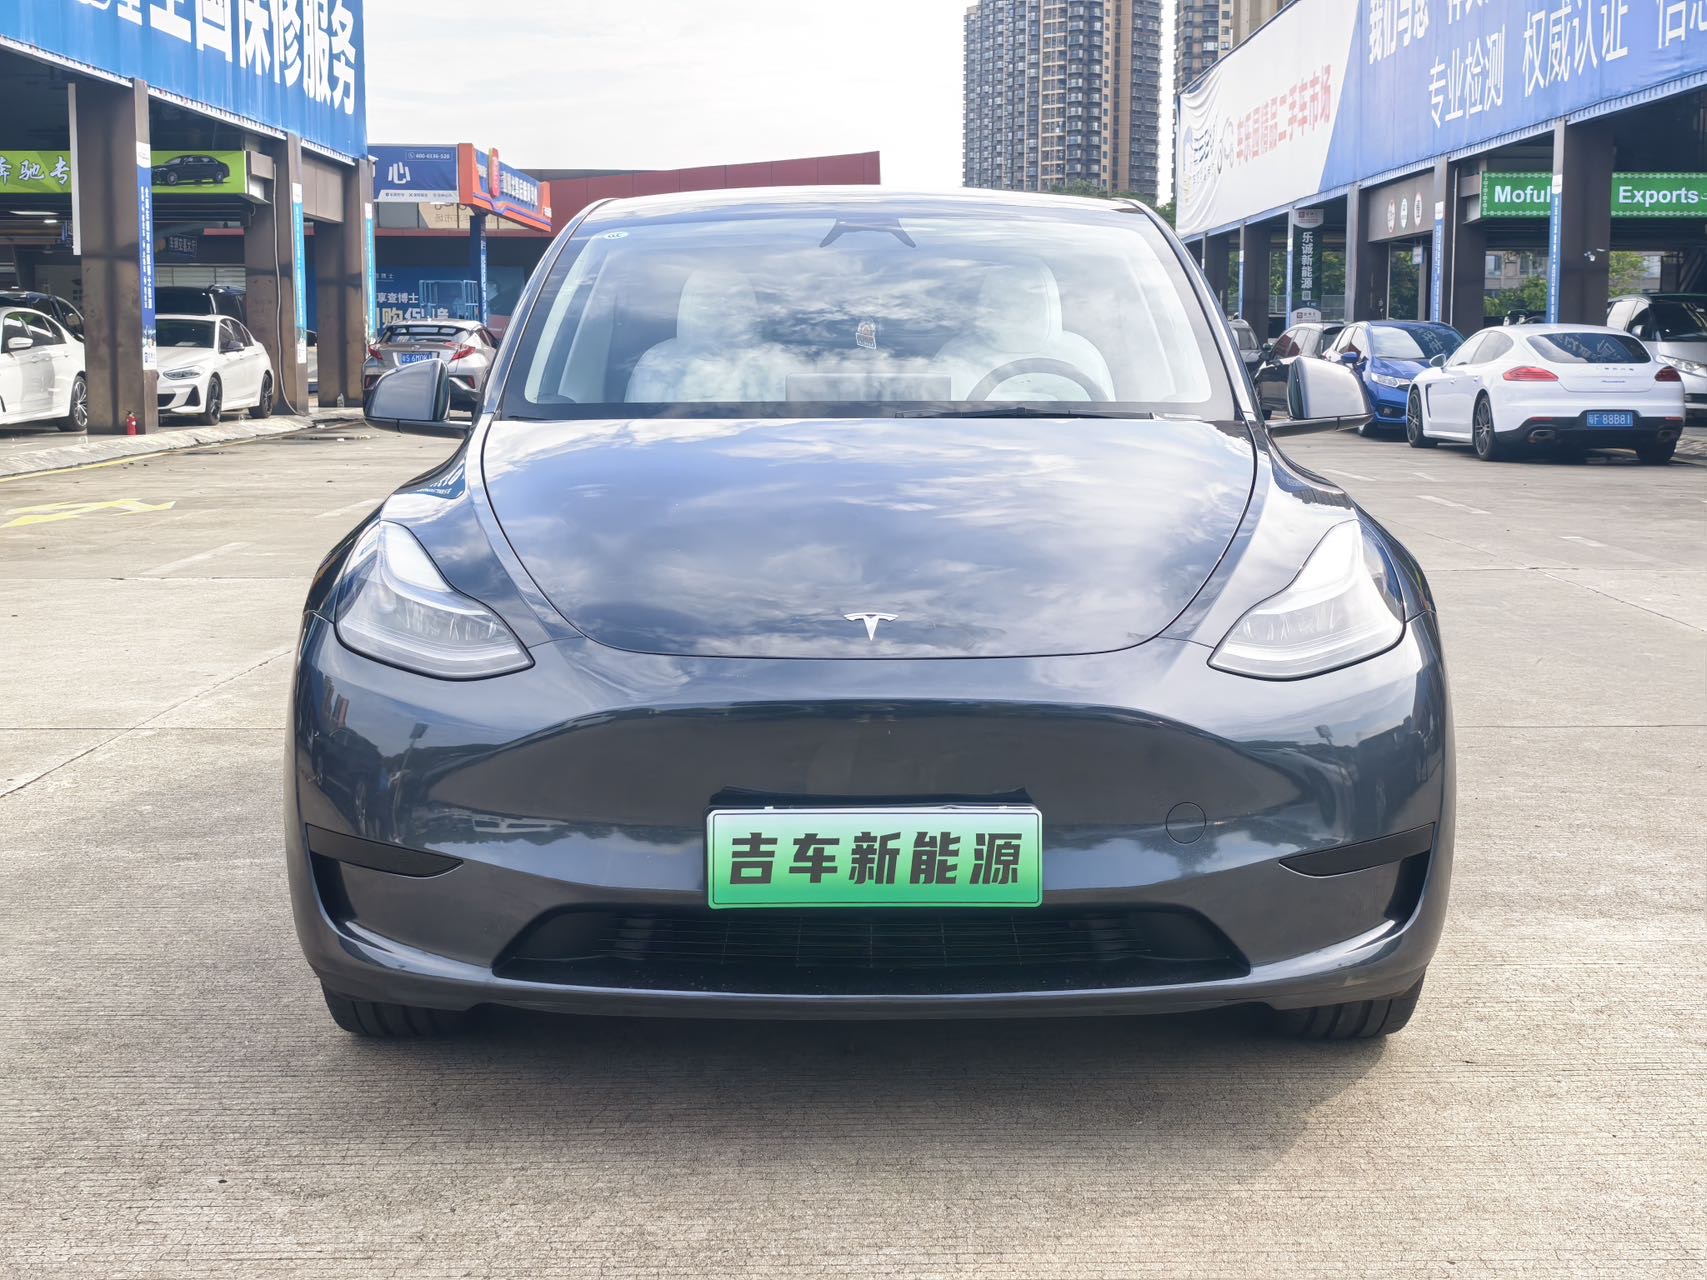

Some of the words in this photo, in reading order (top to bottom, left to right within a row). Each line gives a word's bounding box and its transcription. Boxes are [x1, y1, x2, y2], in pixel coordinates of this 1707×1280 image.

[77, 0, 356, 115] 保修服务
[1428, 24, 1506, 128] 专业检测
[1522, 0, 1628, 97] 权威认证
[388, 161, 411, 184] 心
[1619, 185, 1699, 207] Exports
[1302, 231, 1313, 289] 乐诚新能源
[729, 832, 1023, 885] 吉车新能源
